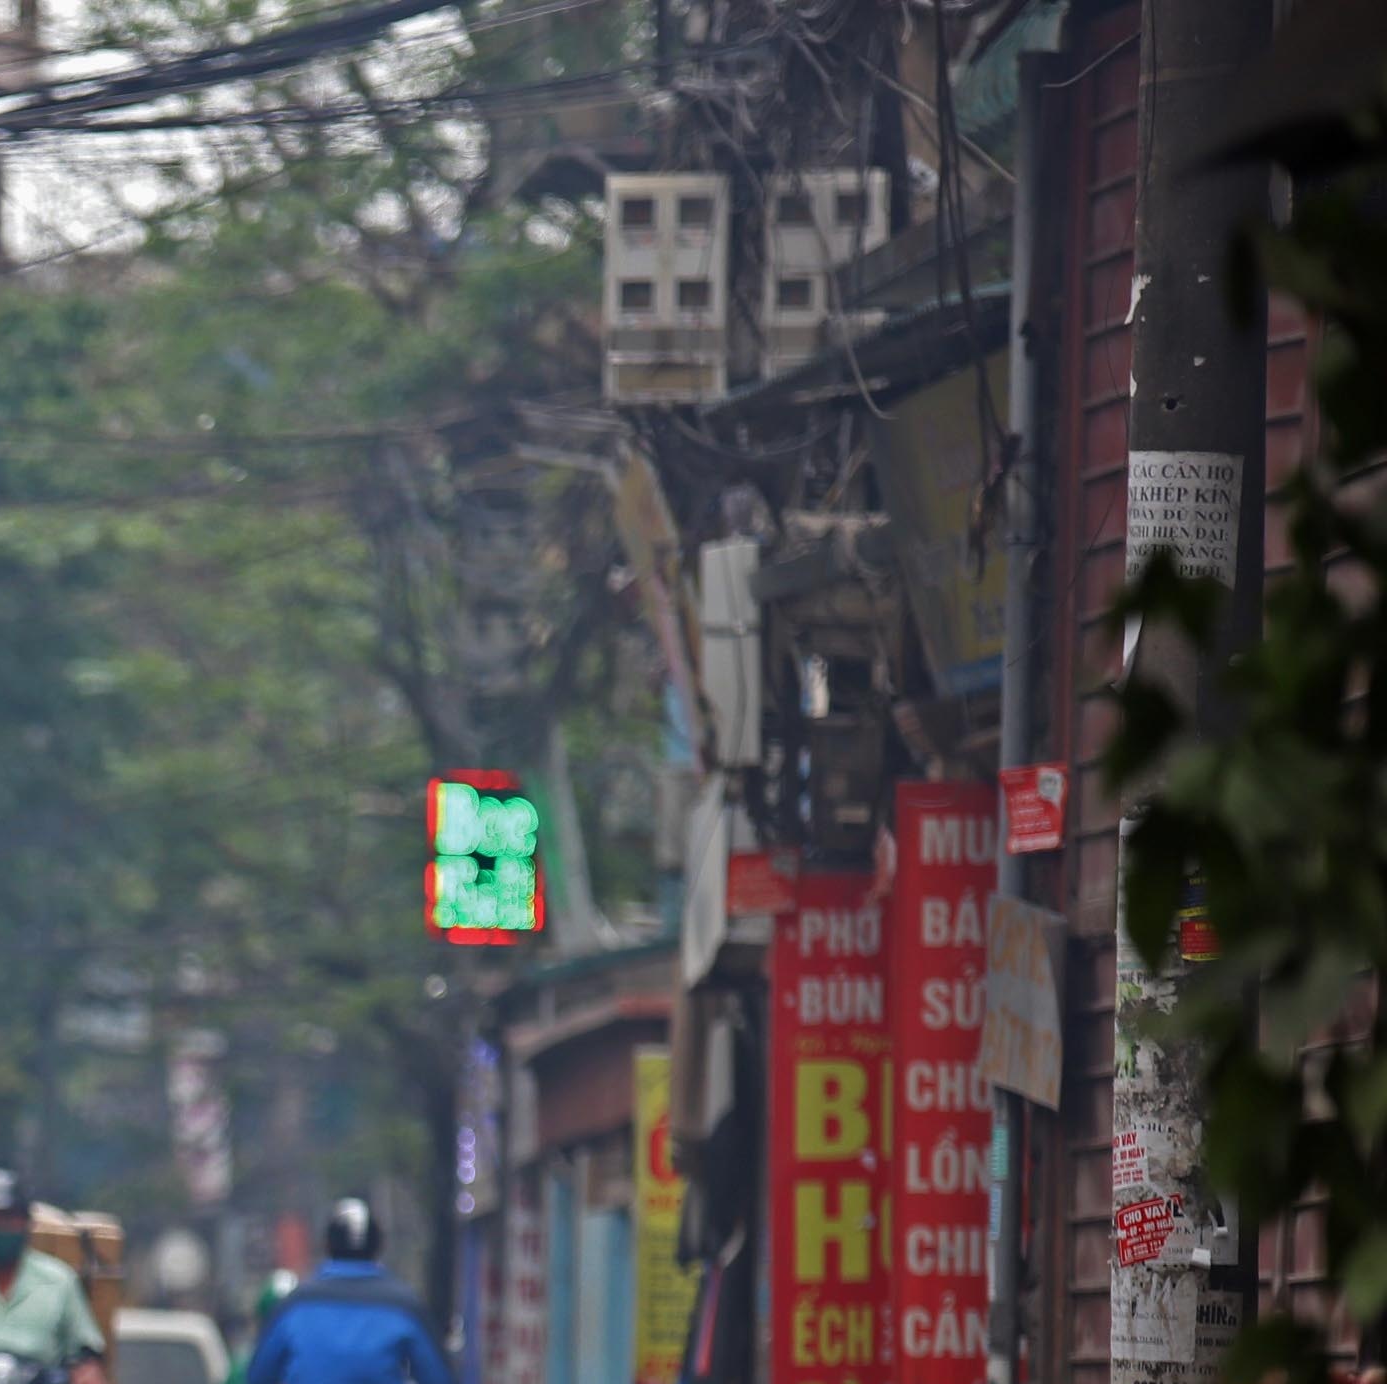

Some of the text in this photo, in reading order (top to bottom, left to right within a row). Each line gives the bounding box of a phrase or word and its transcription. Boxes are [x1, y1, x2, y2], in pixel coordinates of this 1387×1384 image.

[1194, 483, 1232, 505] KÍN
[799, 968, 884, 1025] BÚN
[1123, 1203, 1168, 1227] CHO VAY
